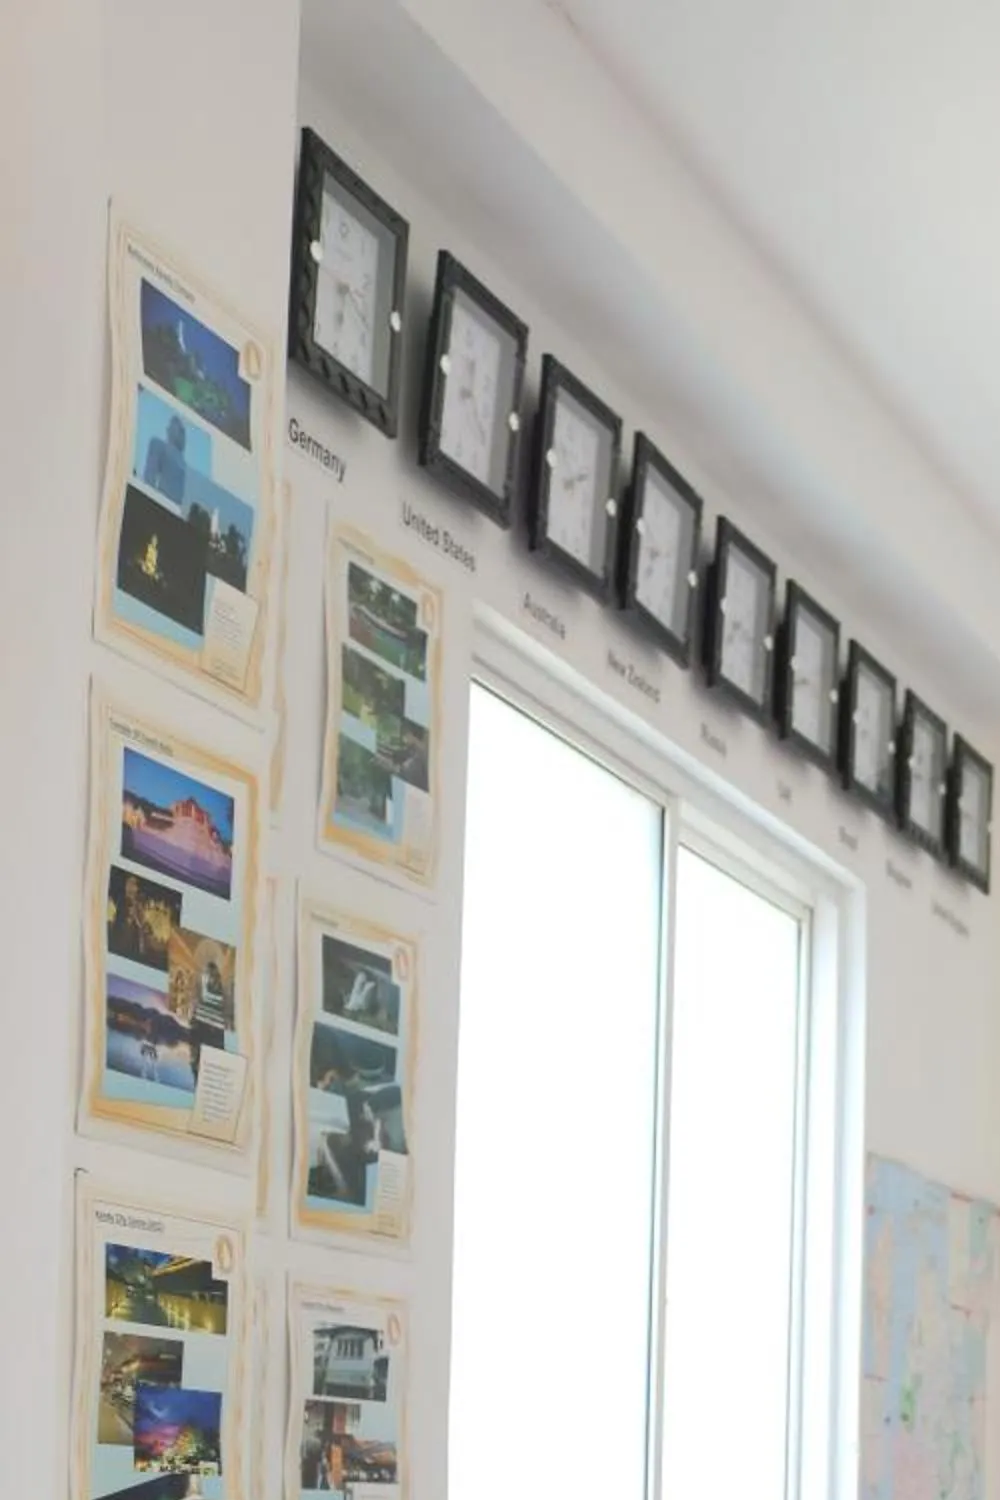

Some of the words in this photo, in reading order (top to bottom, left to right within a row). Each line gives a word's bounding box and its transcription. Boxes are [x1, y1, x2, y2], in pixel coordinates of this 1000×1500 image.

[288, 418, 346, 483] Germany
[402, 501, 439, 546] United
[443, 530, 476, 572] States
